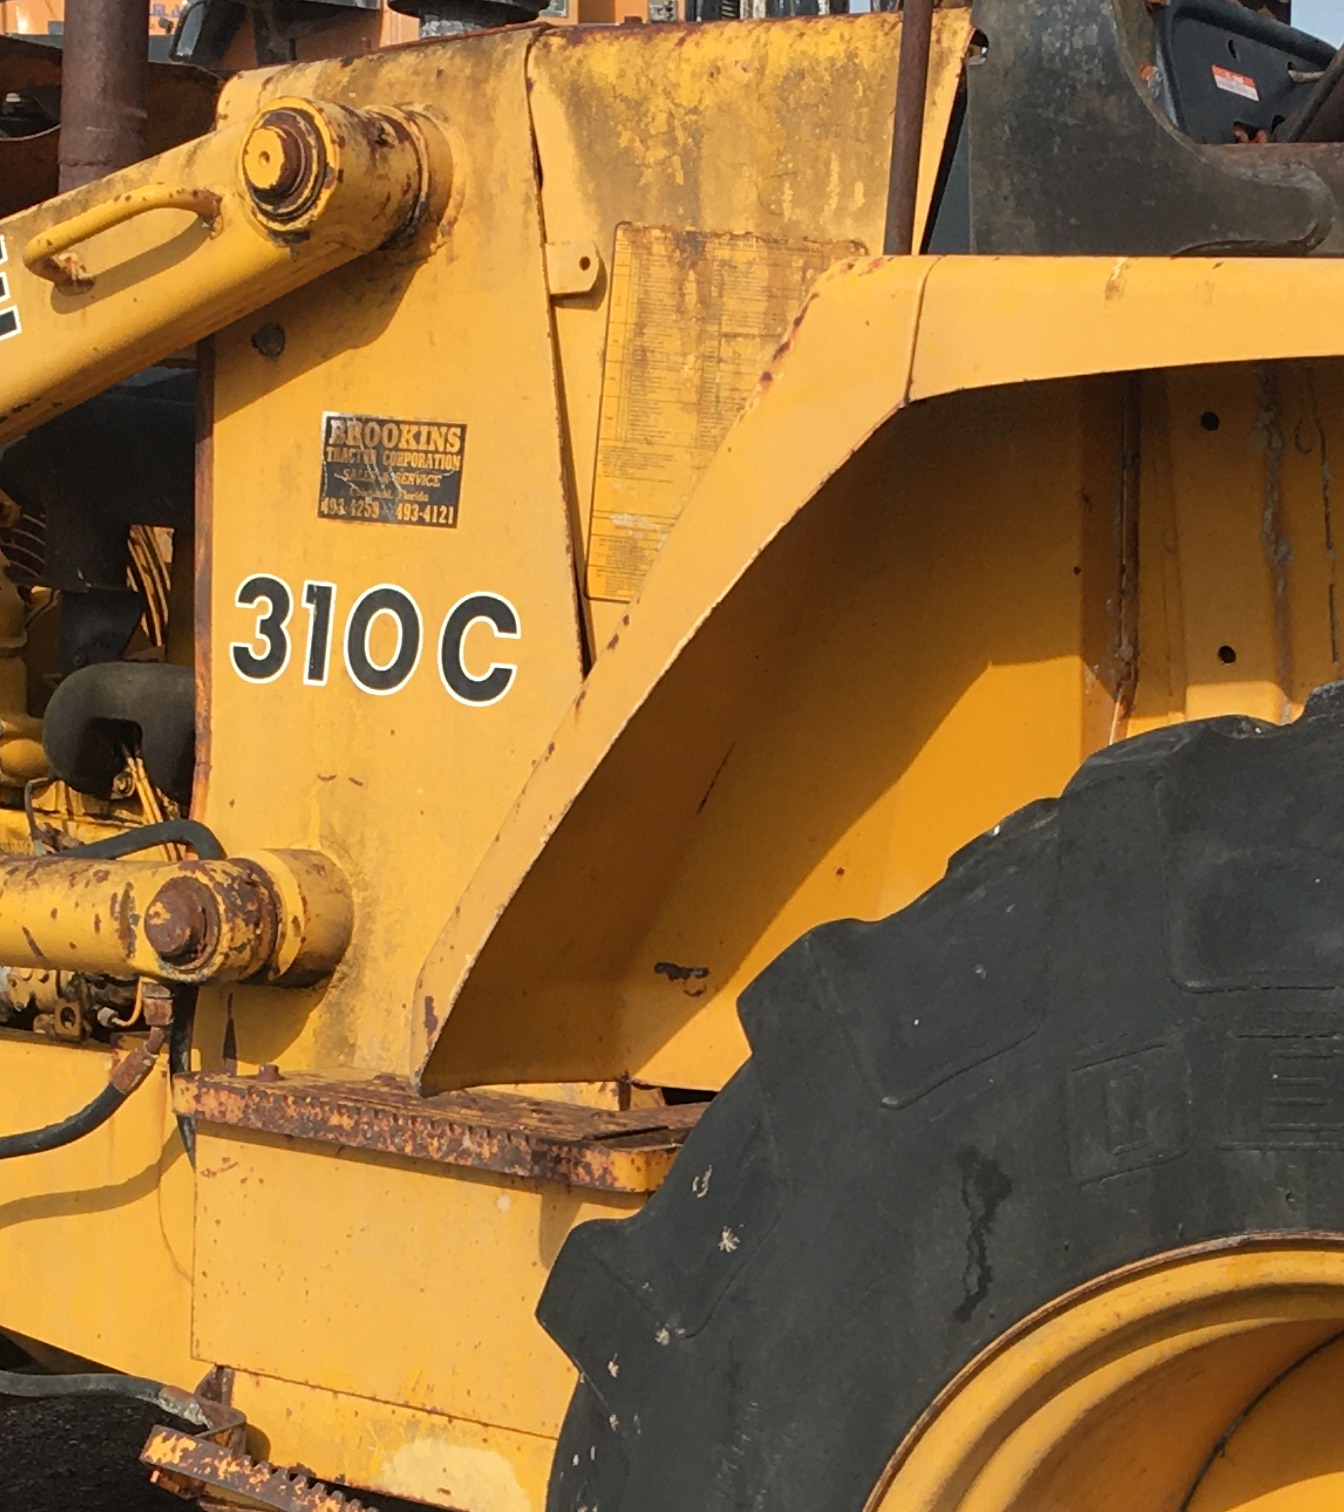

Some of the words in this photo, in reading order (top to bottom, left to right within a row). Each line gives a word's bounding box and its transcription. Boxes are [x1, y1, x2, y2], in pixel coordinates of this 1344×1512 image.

[329, 419, 462, 453] BROOKINS
[383, 450, 461, 471] CORPORATION
[395, 503, 455, 525] 493-4121
